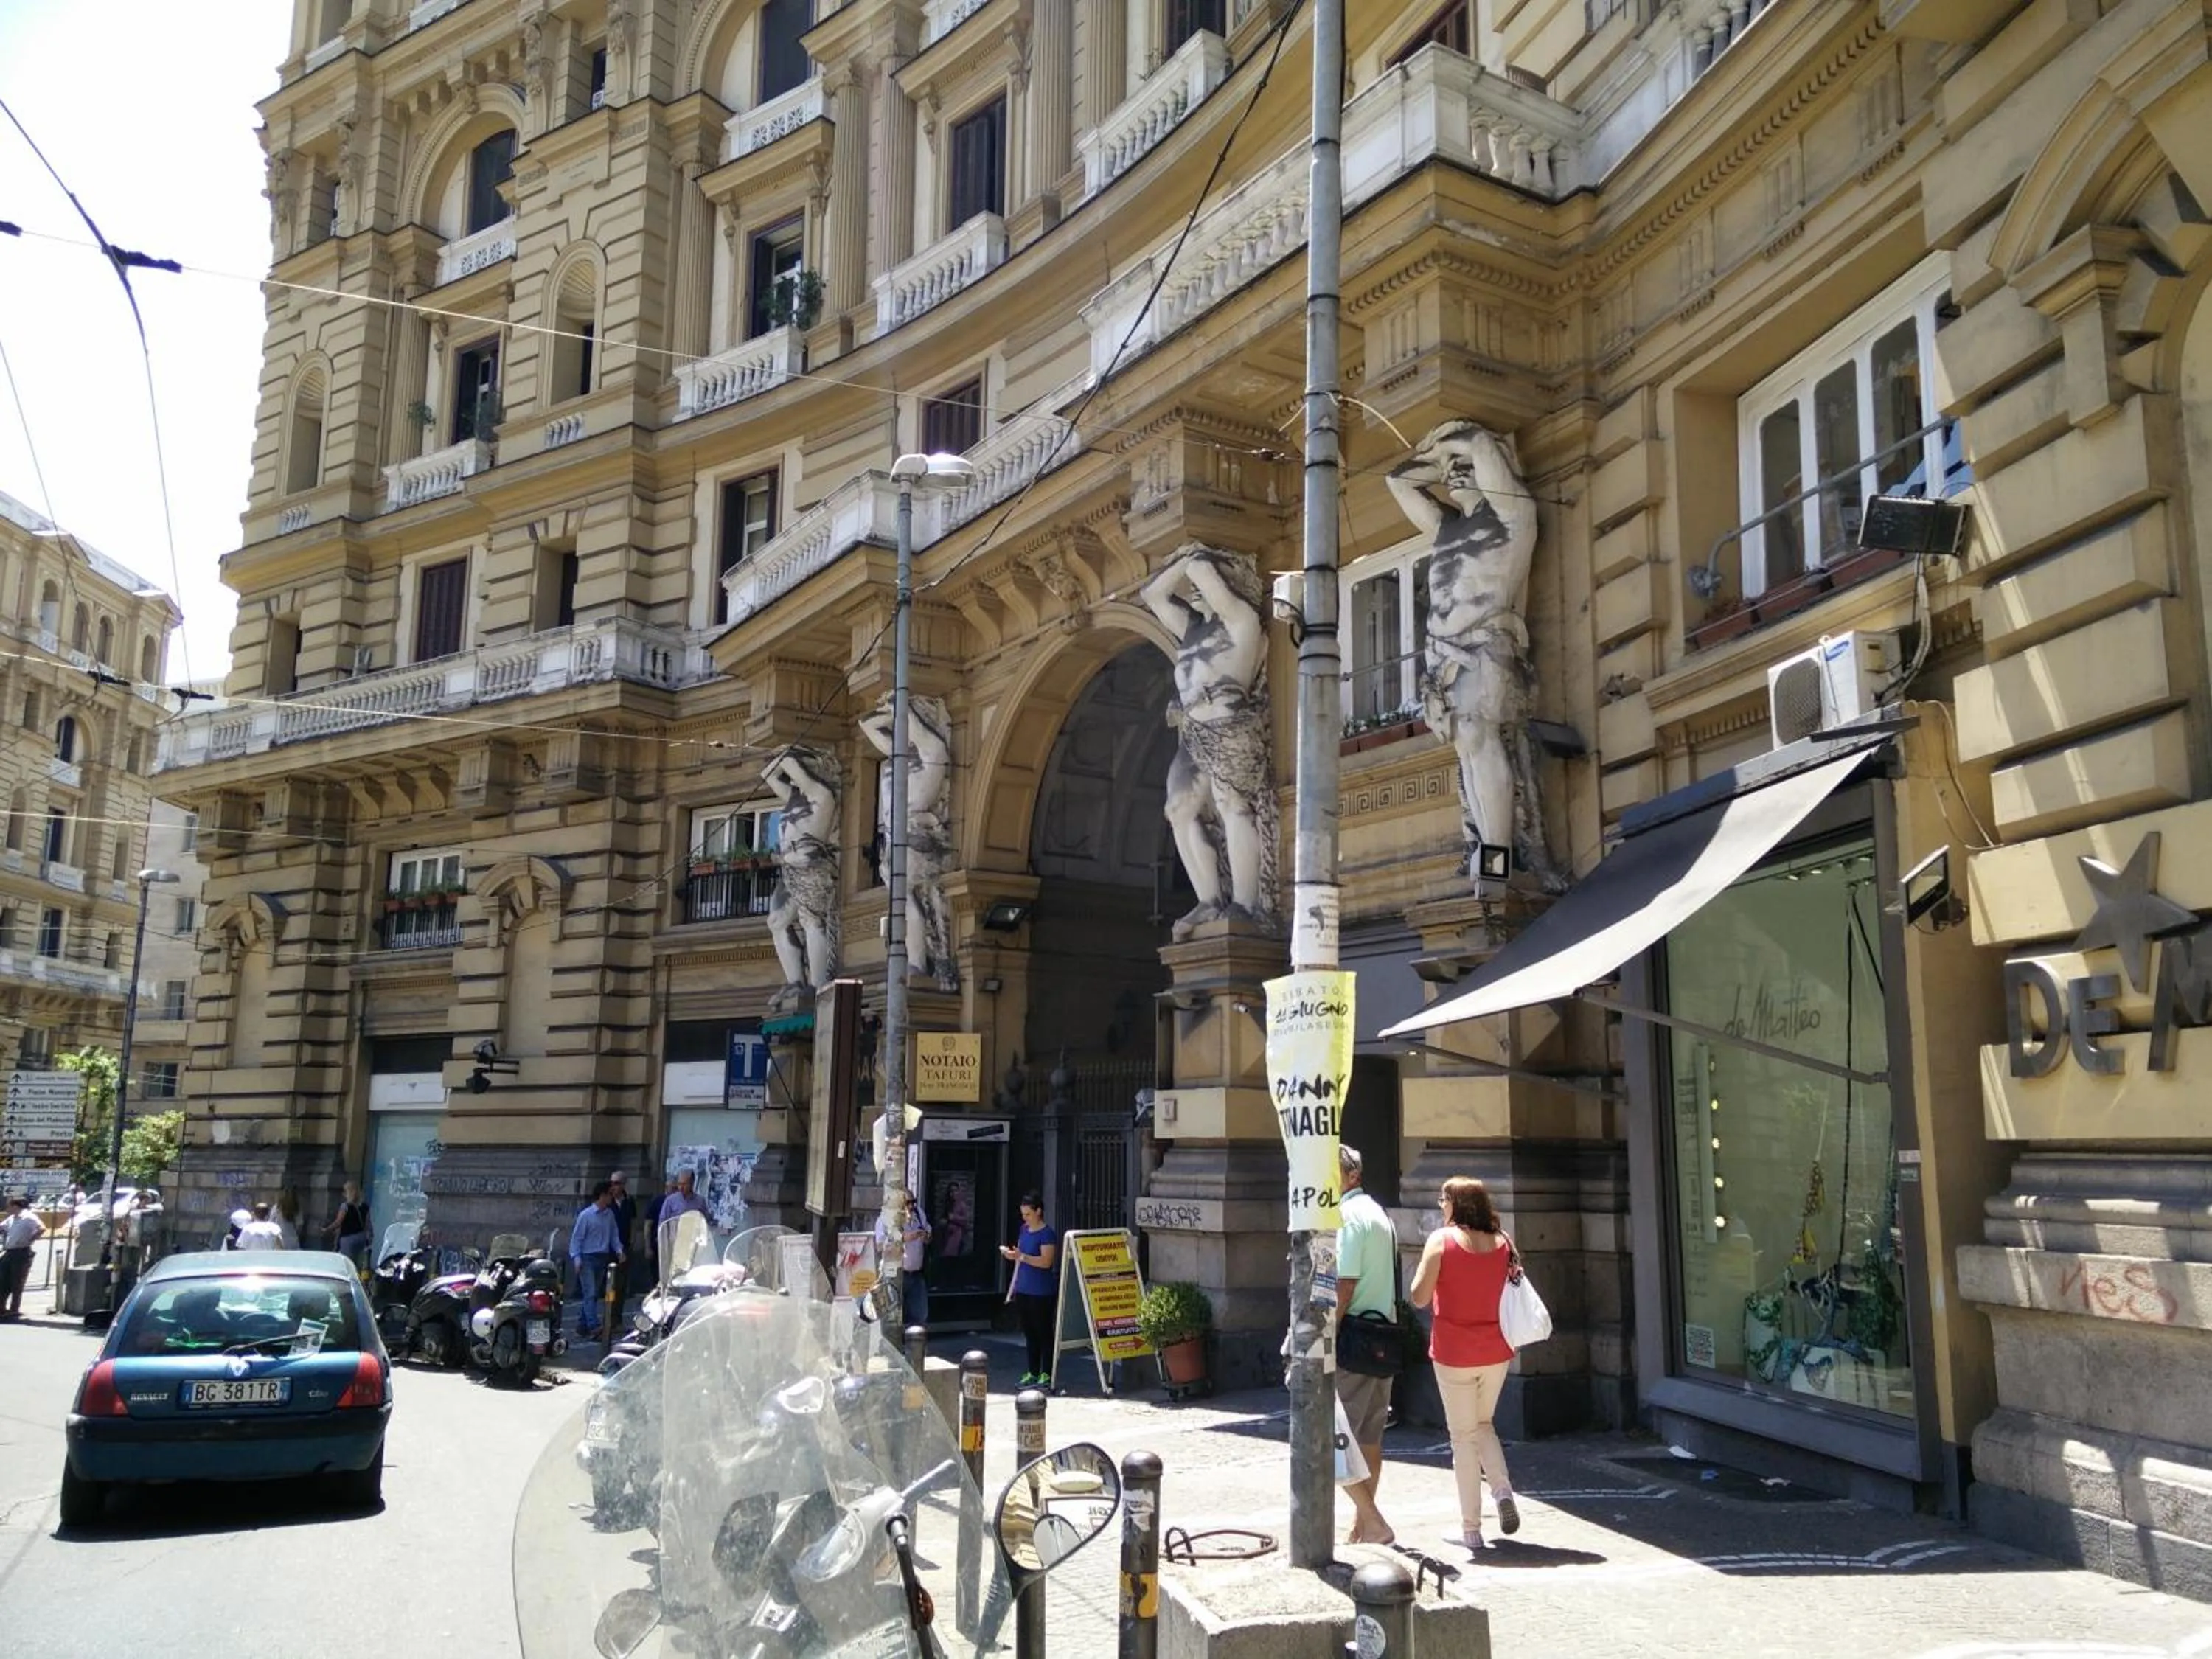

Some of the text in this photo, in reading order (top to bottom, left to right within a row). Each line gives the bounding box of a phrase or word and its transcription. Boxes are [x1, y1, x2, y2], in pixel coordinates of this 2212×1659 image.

[1750, 982, 1821, 1041] Matteo
[2004, 960, 2126, 1077] DE
[734, 1033, 765, 1077] T
[921, 1055, 976, 1067] NOTAIO
[925, 1069, 972, 1080] TAFURI
[1276, 1074, 1346, 1103] DANNY
[195, 1382, 277, 1401] BG 381TR
